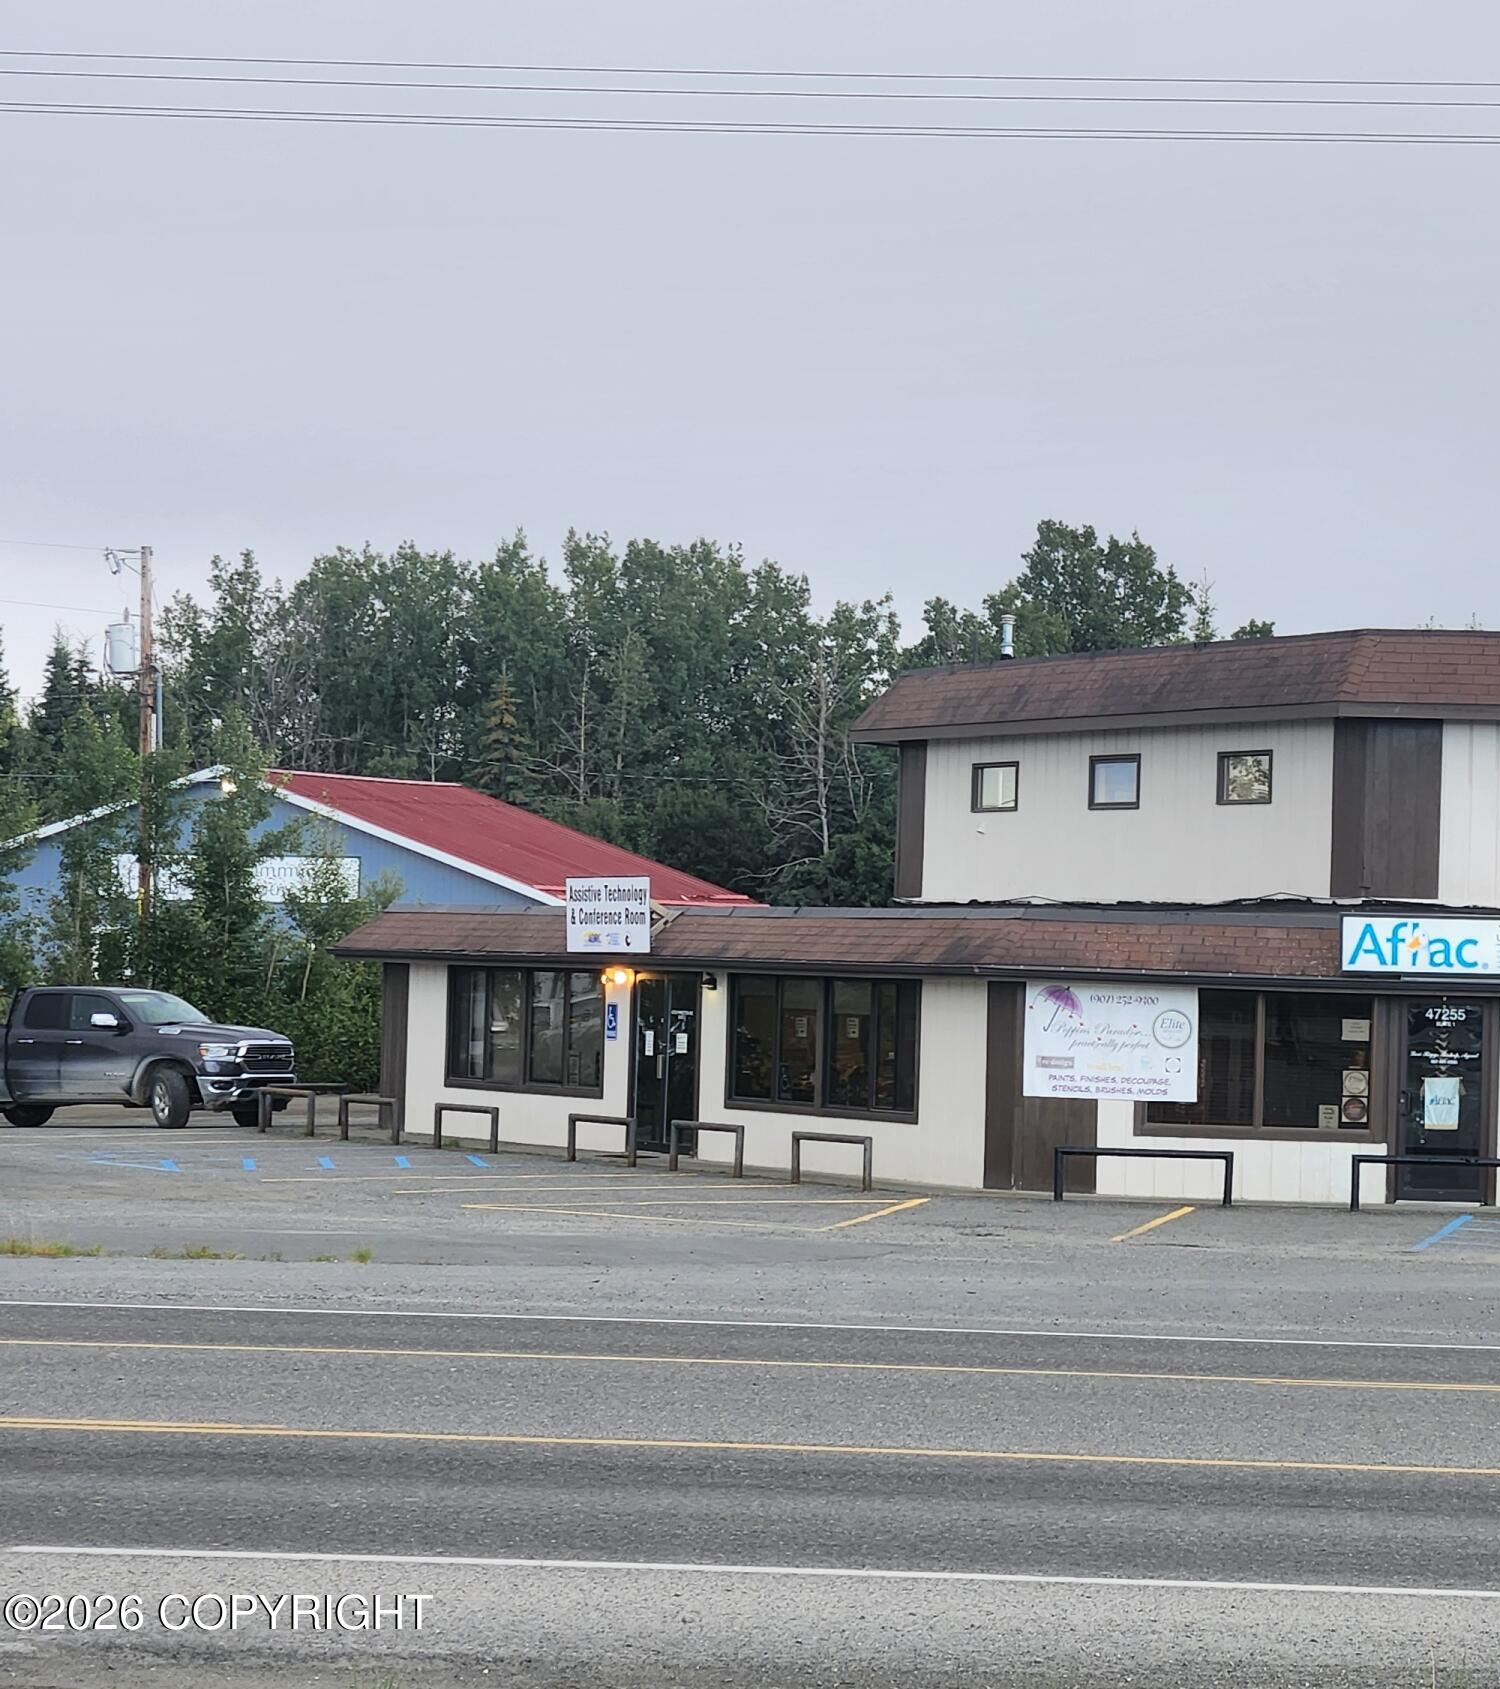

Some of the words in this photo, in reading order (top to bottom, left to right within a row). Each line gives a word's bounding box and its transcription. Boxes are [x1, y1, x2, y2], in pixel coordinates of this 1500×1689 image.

[569, 884, 602, 902] Assistive
[604, 885, 647, 905] Technology
[571, 908, 576, 925] &
[578, 908, 622, 925] Conference
[625, 908, 646, 925] Room
[1425, 1008, 1466, 1020] 47255
[1048, 1074, 1077, 1083] PAINTS,
[1080, 1075, 1119, 1084] FINISHES,
[1051, 1084, 1092, 1093] STENCILS,
[1095, 1086, 1134, 1095] BRUSHES,
